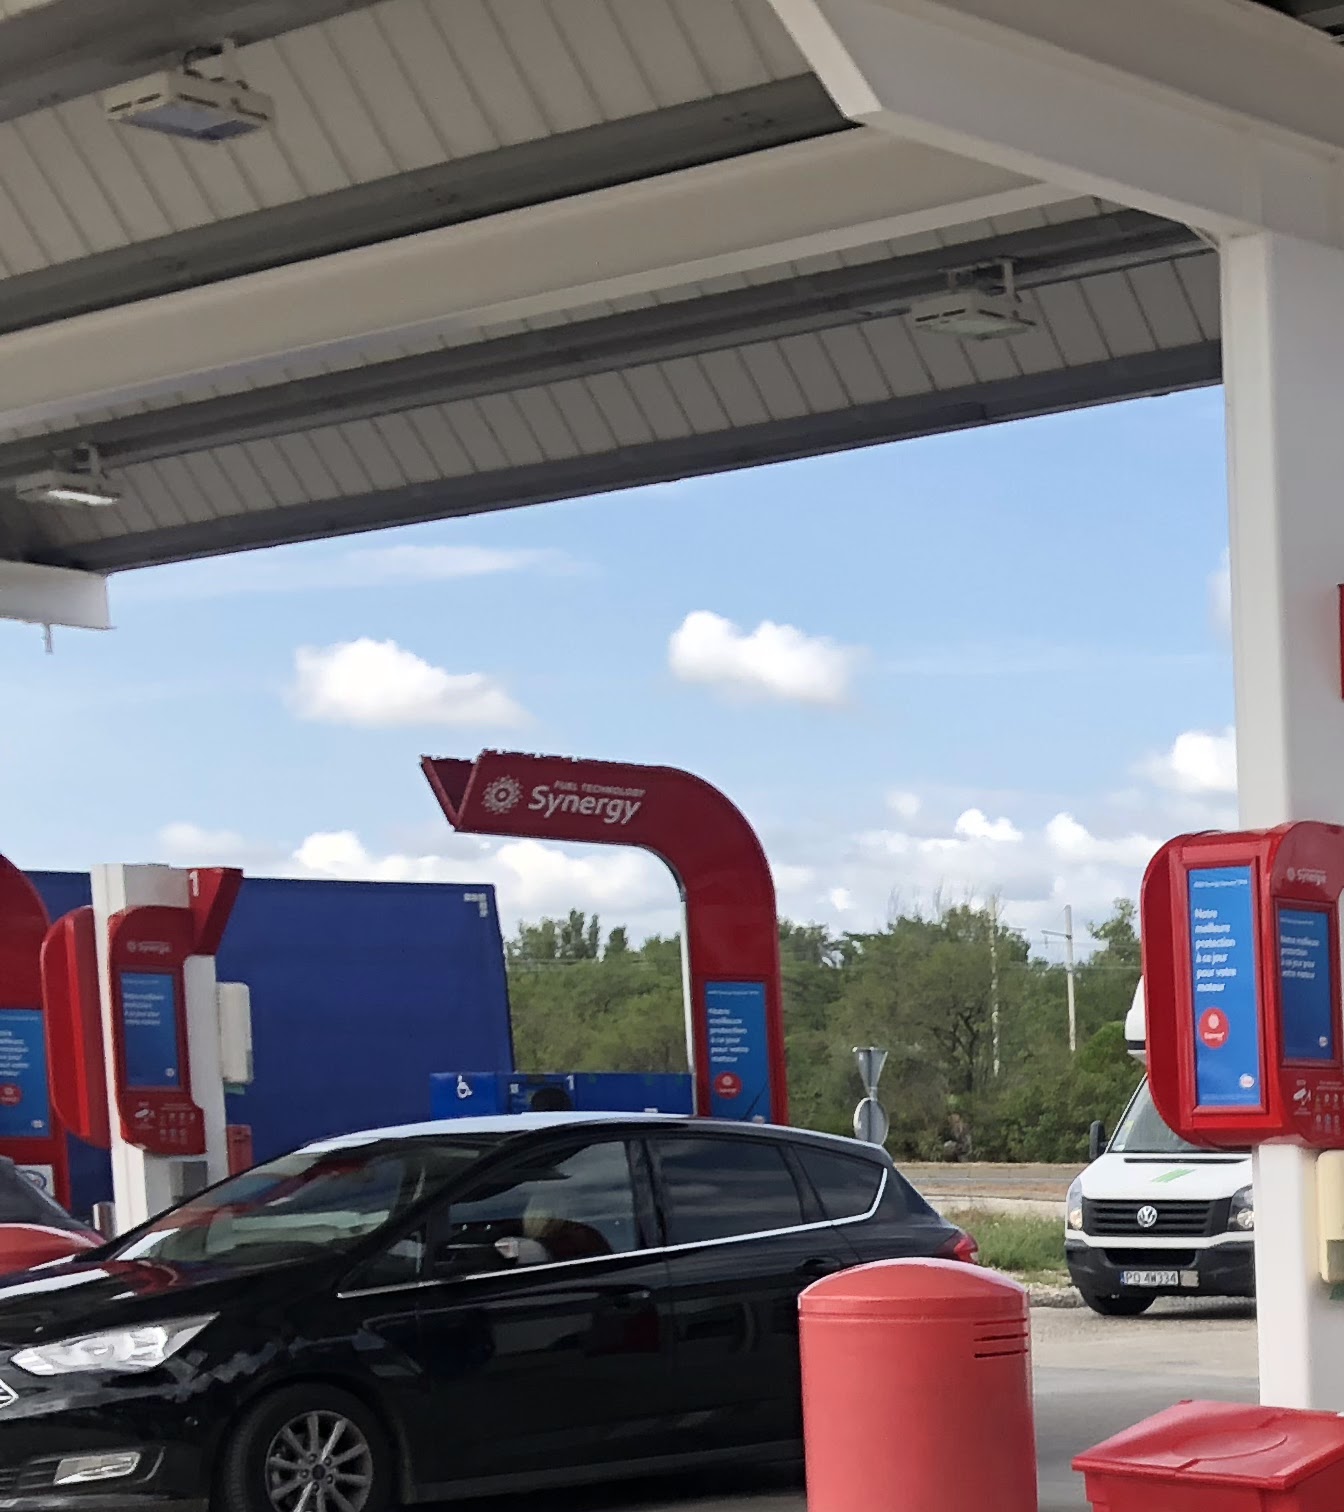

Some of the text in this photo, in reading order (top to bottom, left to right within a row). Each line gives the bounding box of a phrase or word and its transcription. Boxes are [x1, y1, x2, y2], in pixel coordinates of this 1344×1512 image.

[554, 780, 647, 797] FUEL TECHNOLOGY
[528, 785, 642, 824] Synergy
